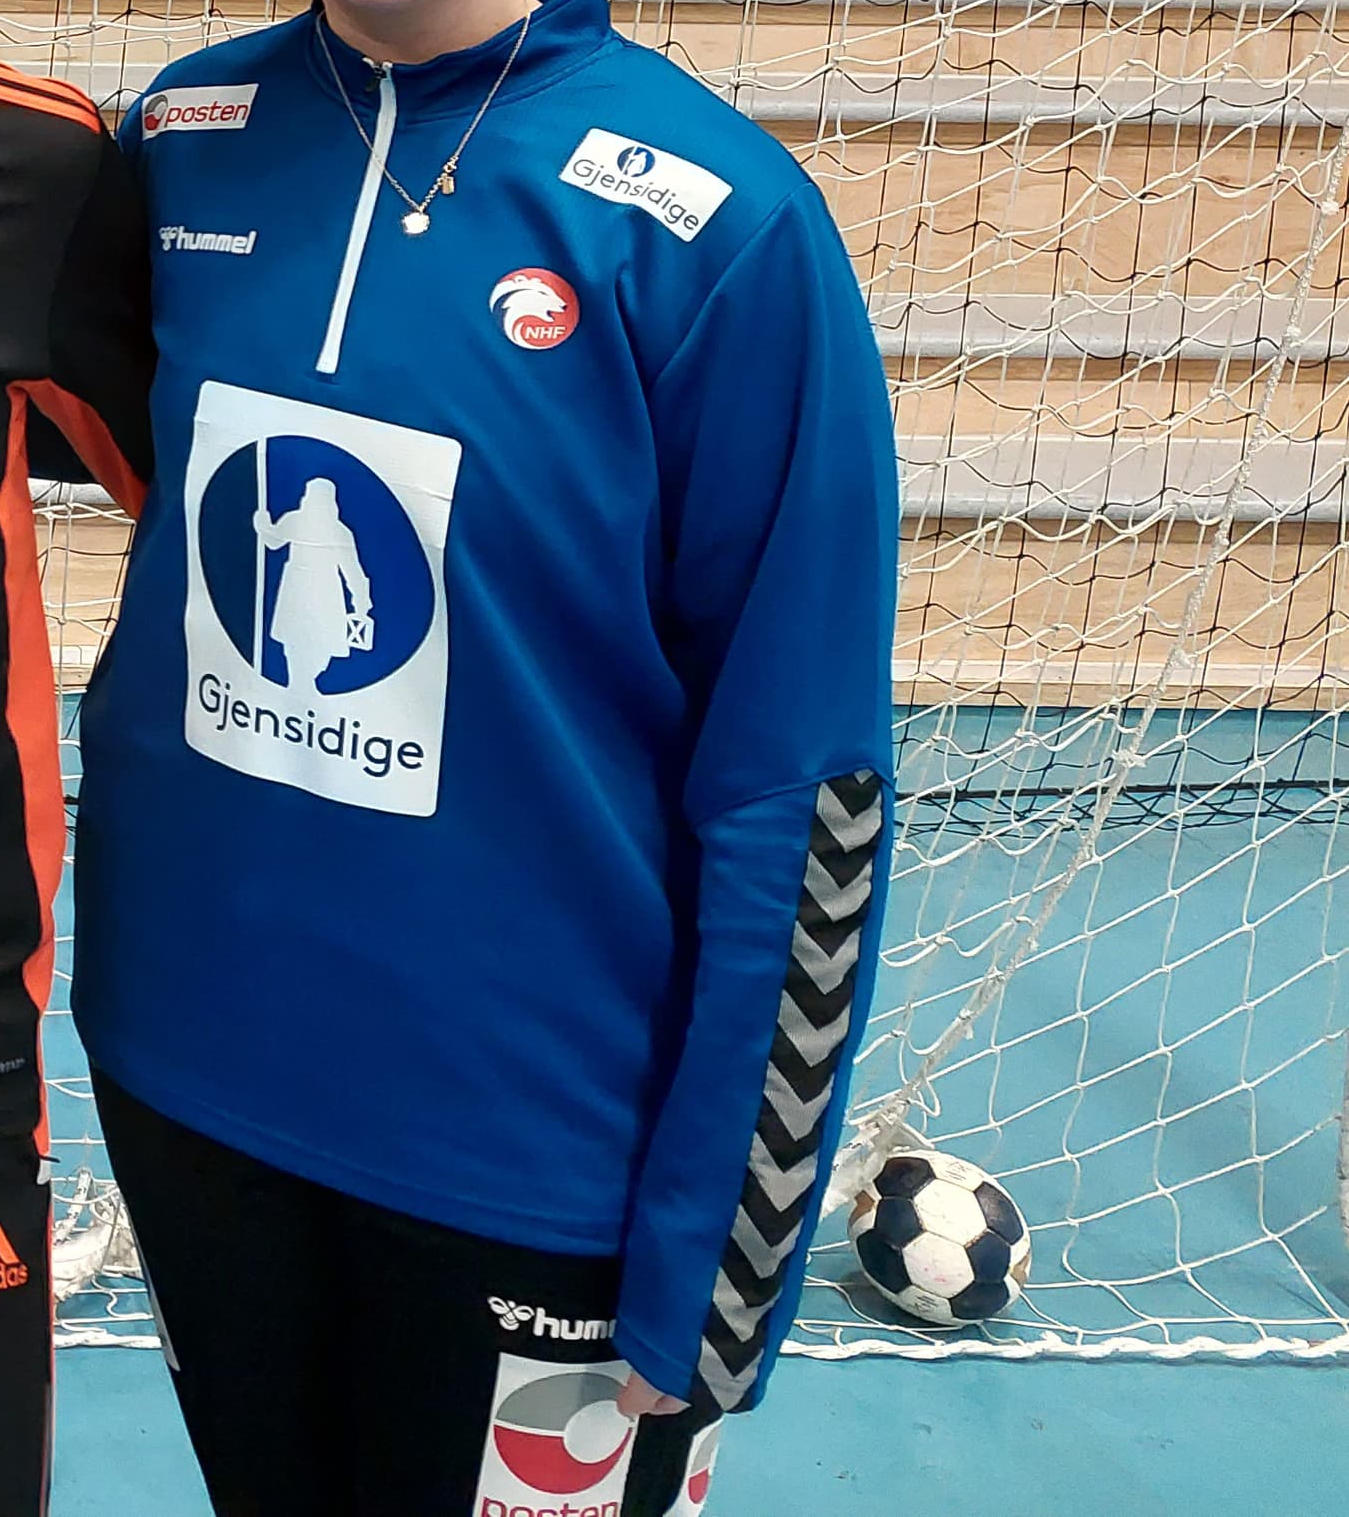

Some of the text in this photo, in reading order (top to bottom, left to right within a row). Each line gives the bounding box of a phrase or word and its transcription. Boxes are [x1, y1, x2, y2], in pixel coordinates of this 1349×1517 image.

[164, 100, 249, 128] posten
[572, 158, 700, 232] Gjensidige
[176, 229, 257, 255] hummel
[525, 324, 566, 341] NHF
[198, 673, 425, 778] Gjensidige
